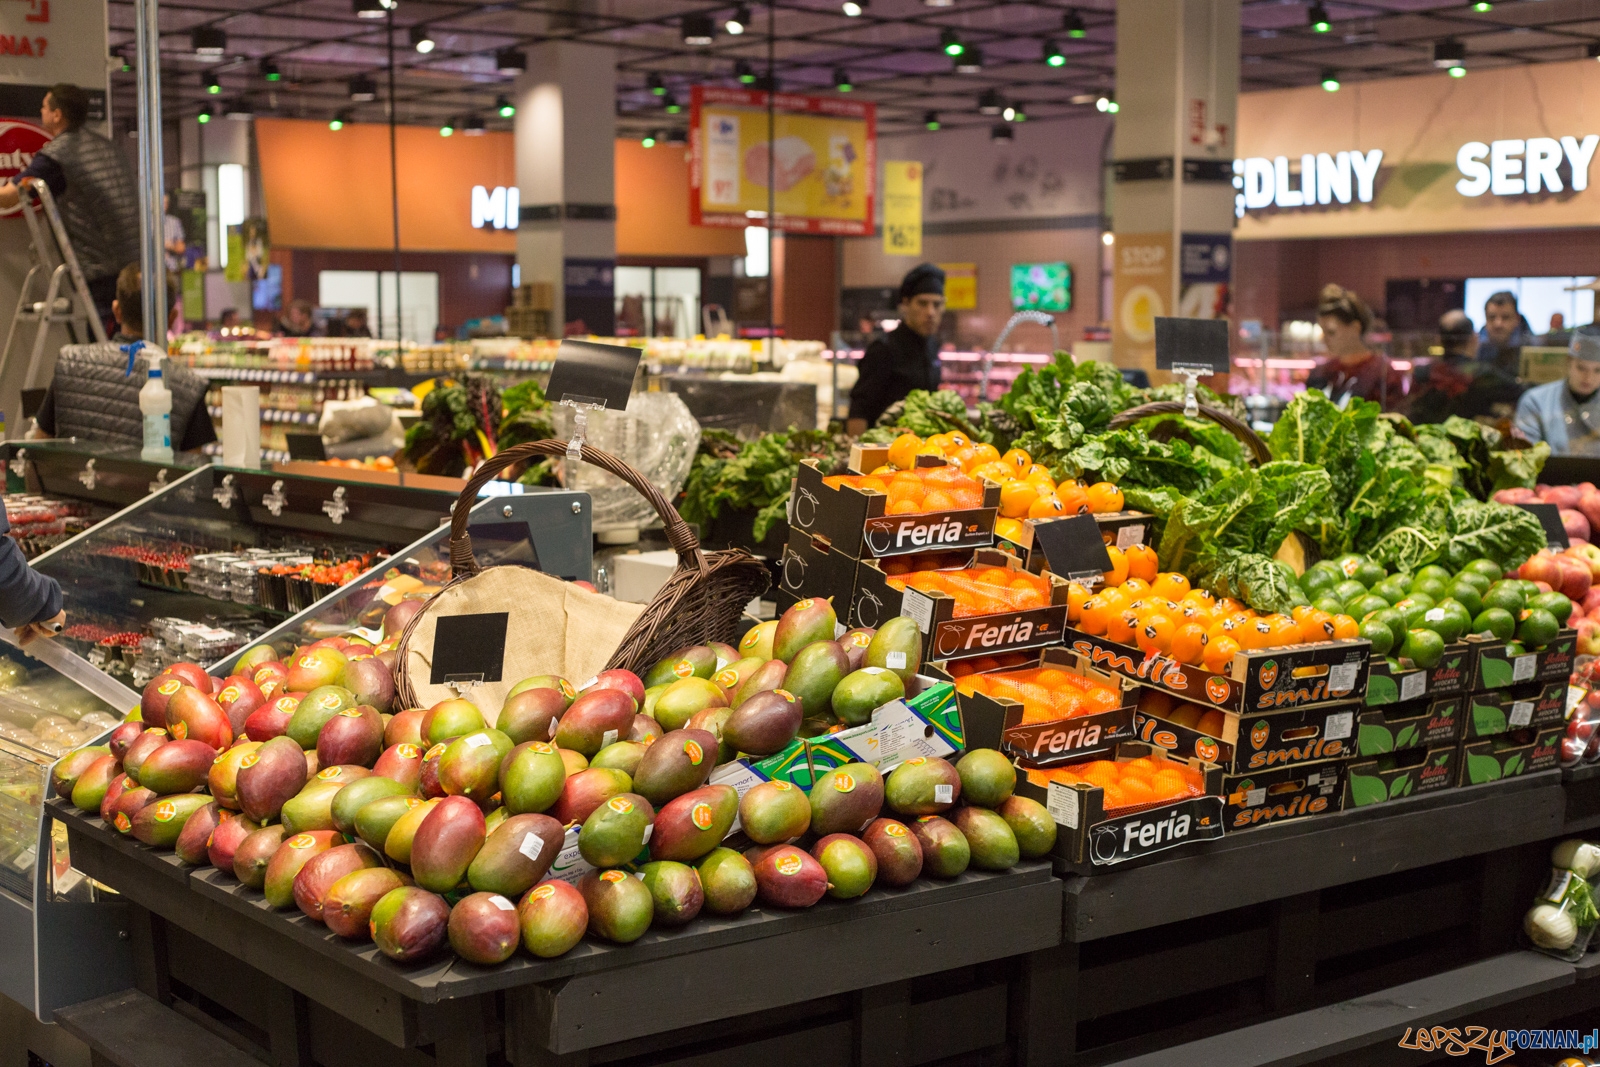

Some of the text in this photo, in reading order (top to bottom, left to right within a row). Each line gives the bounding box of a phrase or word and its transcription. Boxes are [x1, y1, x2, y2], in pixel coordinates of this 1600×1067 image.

[1456, 134, 1600, 197] SERY
[896, 516, 962, 548] Feria
[964, 616, 1034, 651] Feria
[1032, 720, 1101, 757] Feria
[1248, 737, 1343, 768] smile
[1233, 793, 1328, 827] smile
[1122, 810, 1191, 853] Feria
